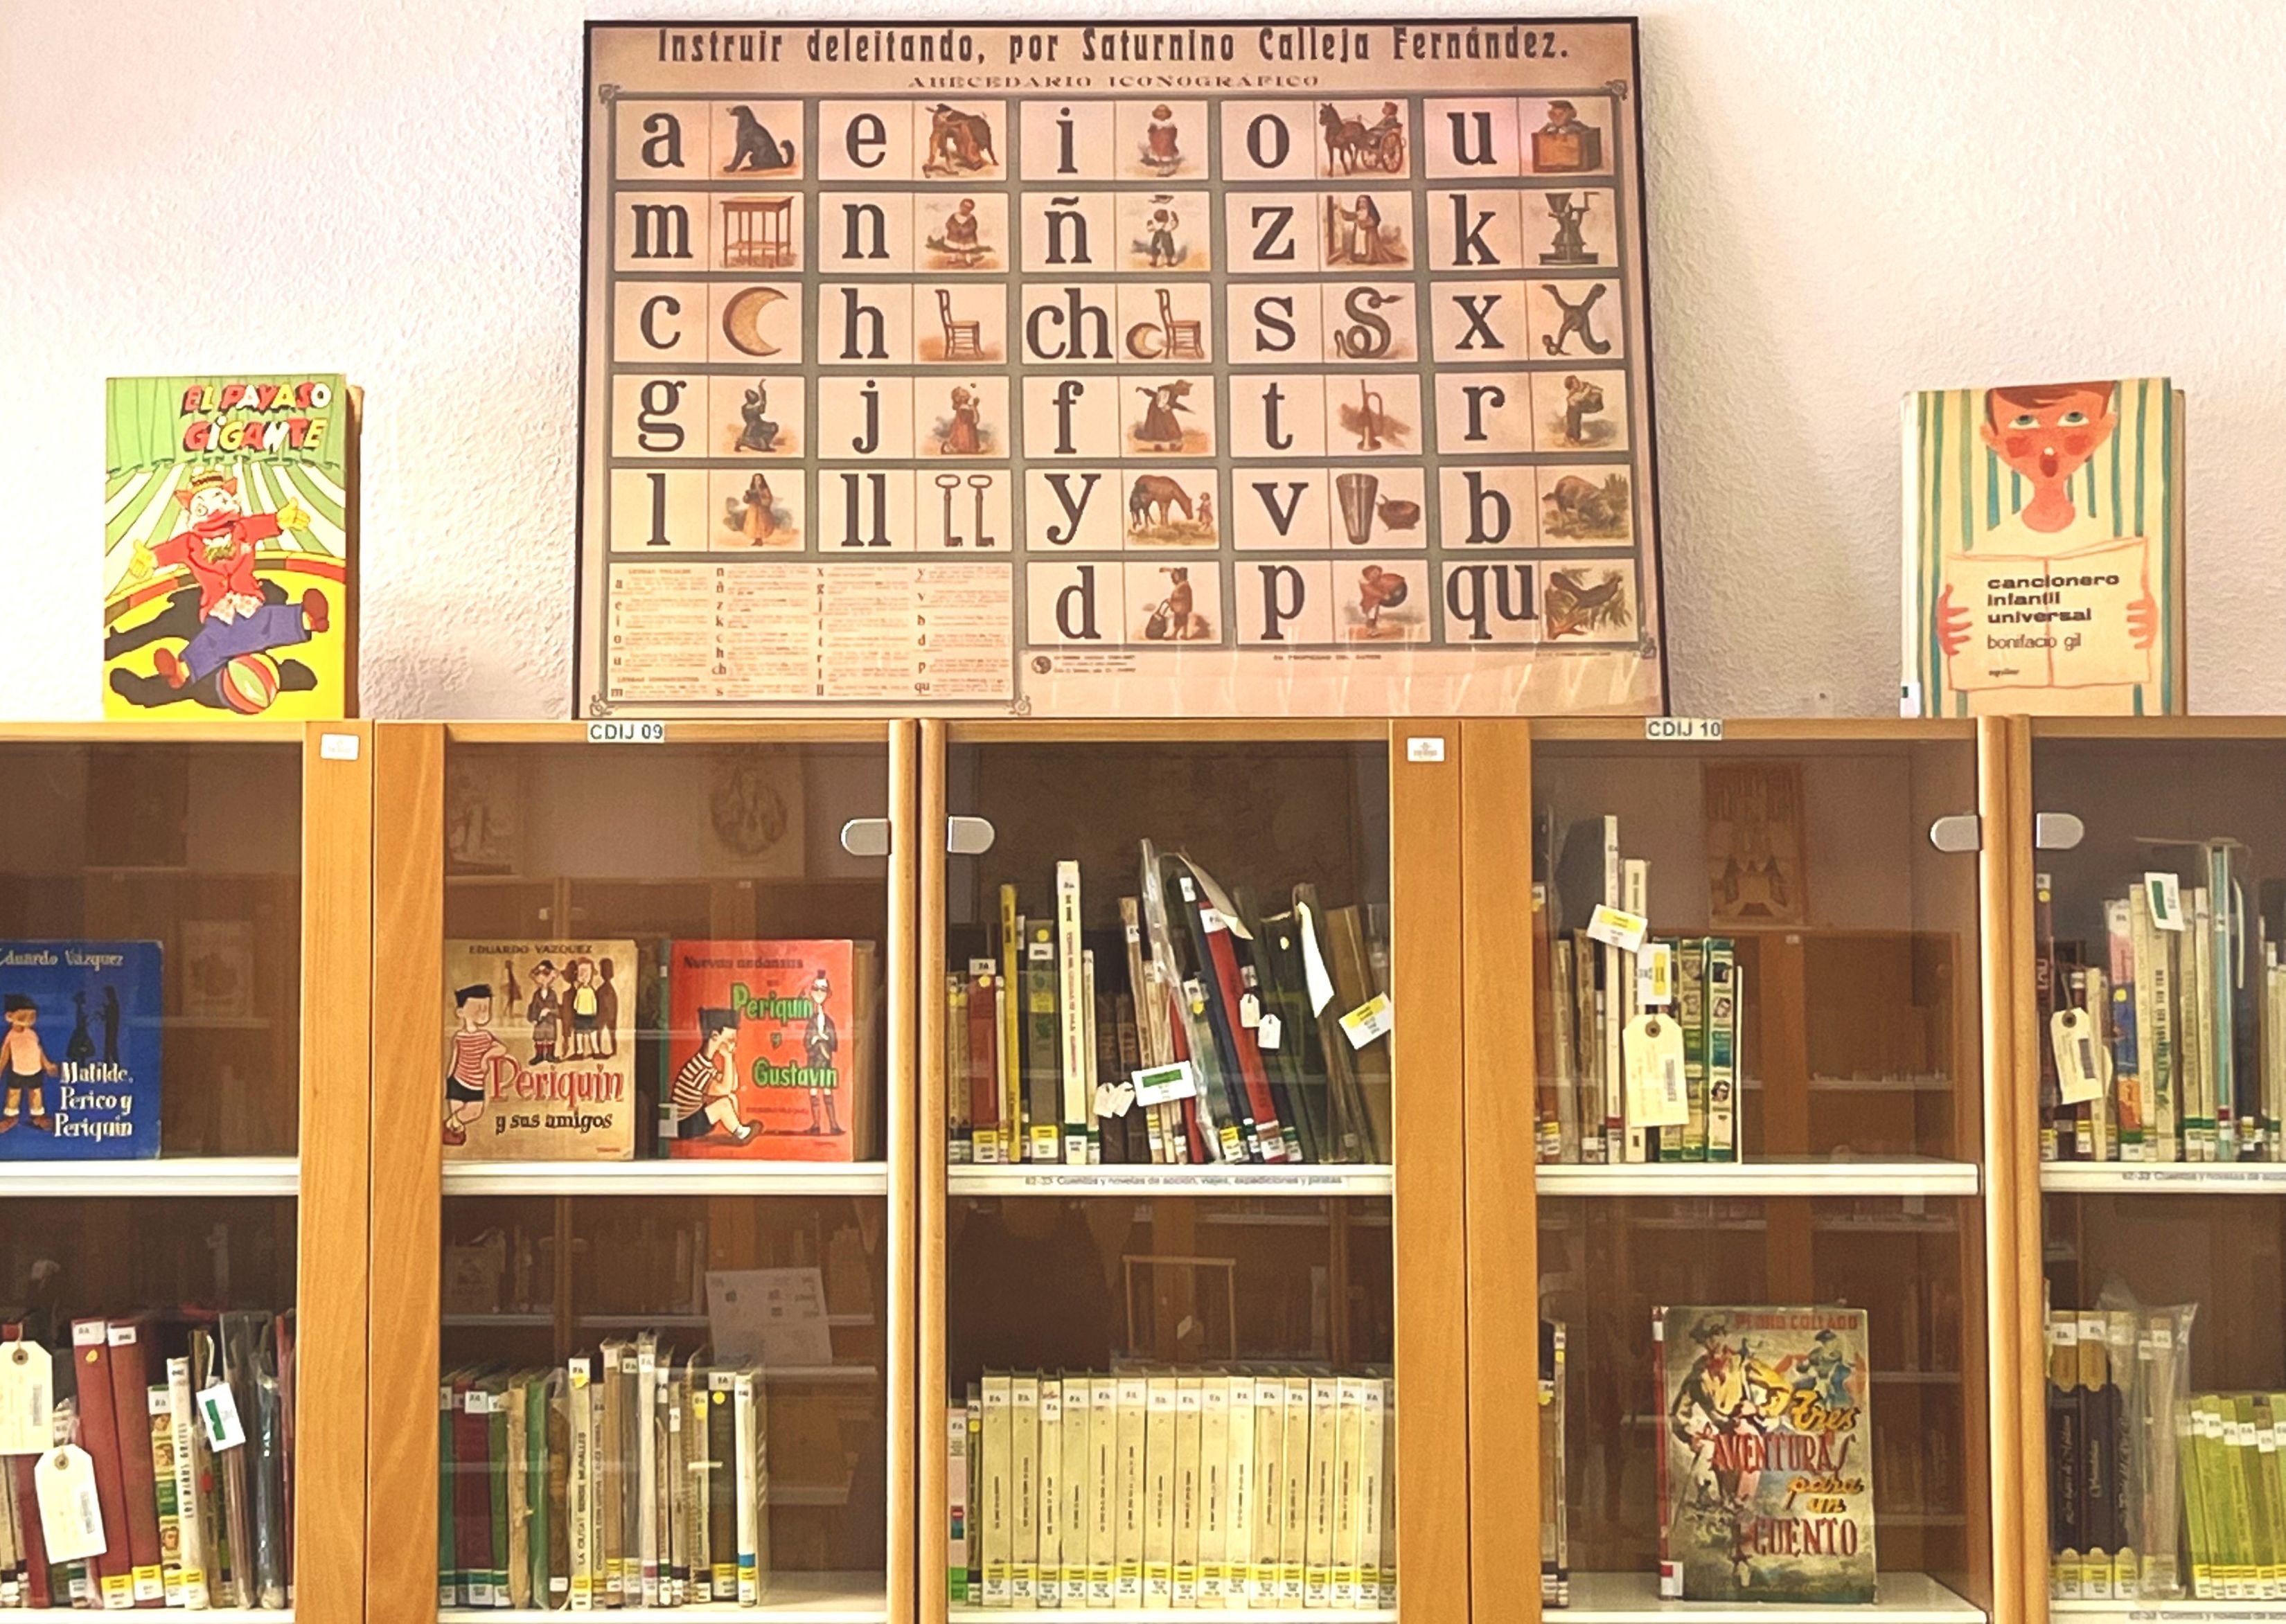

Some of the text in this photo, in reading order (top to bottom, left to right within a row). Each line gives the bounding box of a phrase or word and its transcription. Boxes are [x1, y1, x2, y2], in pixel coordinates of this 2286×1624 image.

[658, 26, 1569, 64] Instruir deleitando, por Saturnino Calleja Fernández.
[908, 75, 1092, 88] ABECEDARIO
[641, 112, 685, 168] a
[846, 113, 887, 168] e
[1056, 107, 1079, 174] i
[1247, 114, 1290, 169] o
[1446, 111, 1498, 166] u
[630, 204, 693, 259] m
[842, 204, 890, 259] n
[1044, 196, 1092, 265] ñ
[1251, 206, 1295, 260] z
[1448, 193, 1500, 266] k
[640, 295, 681, 350] c
[840, 287, 889, 359] h
[1026, 287, 1113, 359] ch
[1254, 296, 1296, 352] s
[1452, 294, 1505, 350] x
[184, 382, 332, 413] EL PAYASO
[637, 380, 687, 452] g
[852, 380, 879, 454] j
[1052, 380, 1084, 454] f
[1261, 382, 1293, 450] t
[1462, 386, 1505, 441] r
[646, 472, 671, 546] l
[840, 473, 892, 547] ll
[1044, 473, 1101, 546] y
[1252, 482, 1309, 536] v
[1462, 470, 1511, 544] b
[1056, 565, 1101, 640] d
[1257, 564, 1305, 641] p
[1446, 564, 1539, 640] qu
[1987, 574, 2120, 589] cancionero
[1987, 591, 2060, 606] infantil
[1987, 608, 2092, 623] universal
[1987, 633, 2081, 652] bonifacio gil
[590, 724, 663, 740] CDIJ 09
[1648, 721, 1721, 737] CDIJ 10
[469, 945, 529, 954] EDUARDO
[60, 1086, 132, 1116] Perico y
[495, 1109, 613, 1135] y sus amigos
[1751, 1517, 1858, 1557] CUENTO
